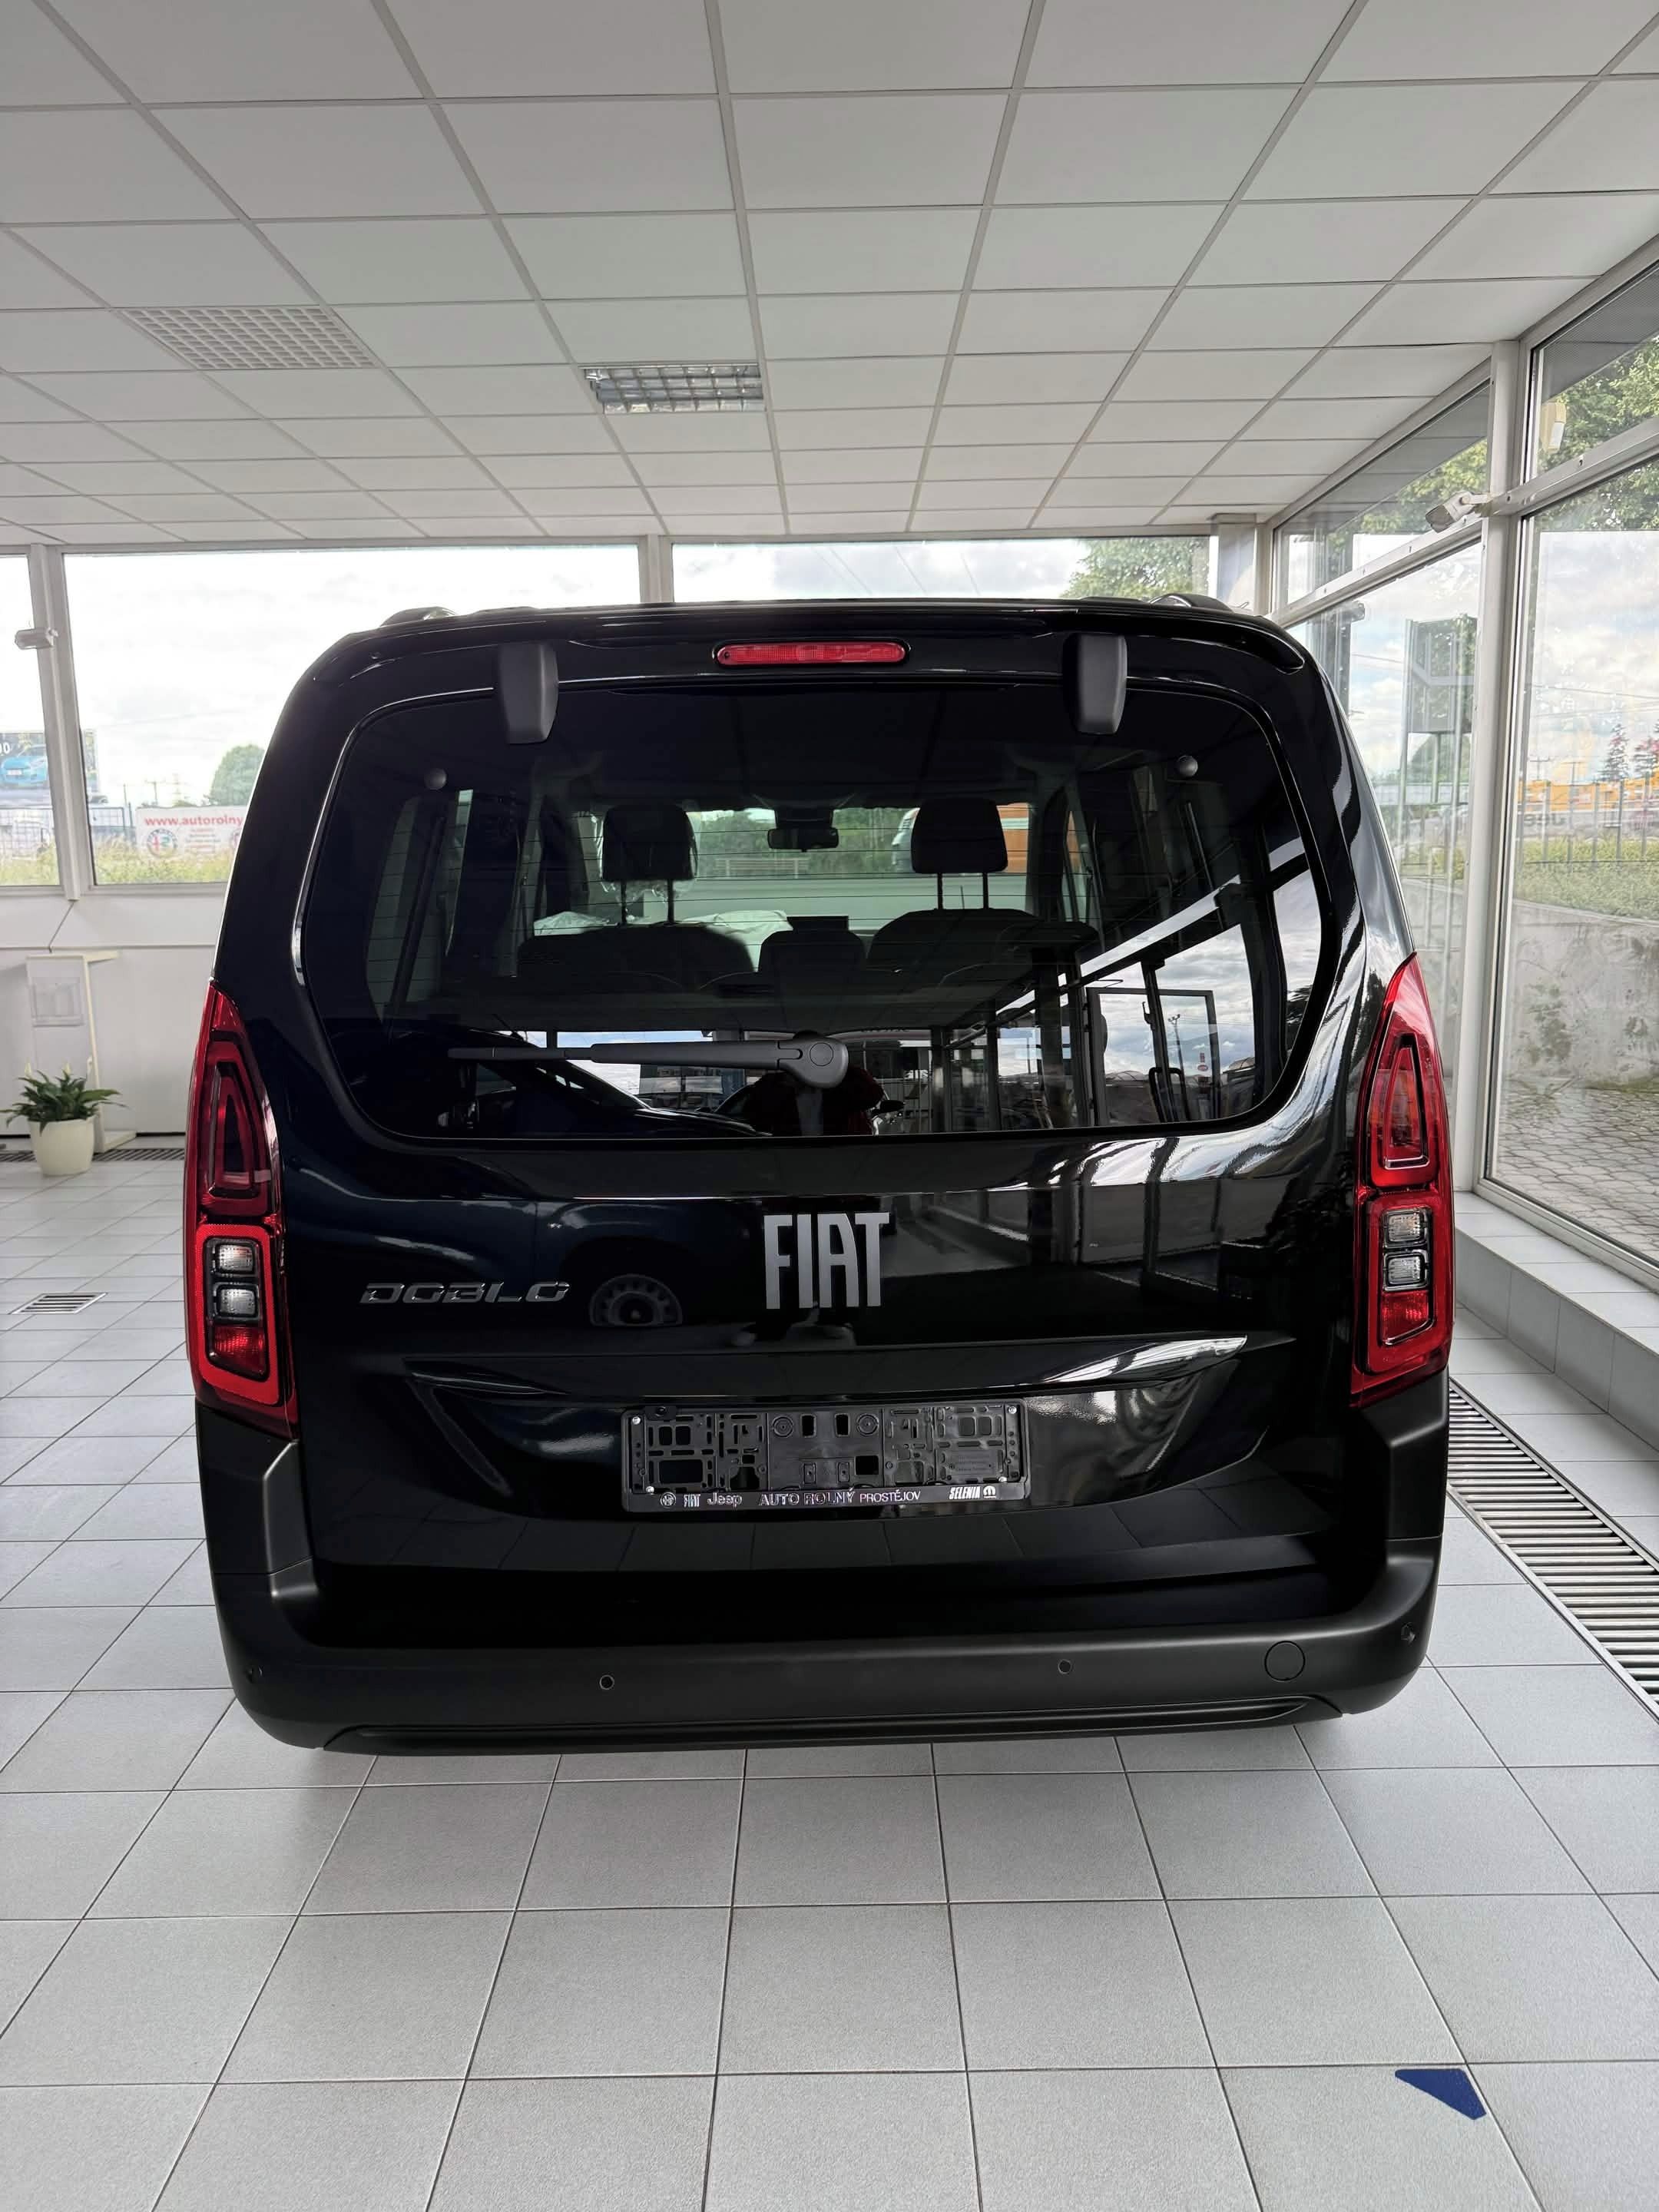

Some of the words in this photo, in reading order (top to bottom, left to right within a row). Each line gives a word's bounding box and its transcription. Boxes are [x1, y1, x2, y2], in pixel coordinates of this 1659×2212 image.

[763, 1212, 889, 1309] FIAT
[684, 1494, 700, 1508] FIAT
[707, 1492, 743, 1508] Jeep
[759, 1492, 800, 1506] AUTO
[803, 1487, 856, 1505] ROLNÝ
[949, 1485, 981, 1500] SELENIA
